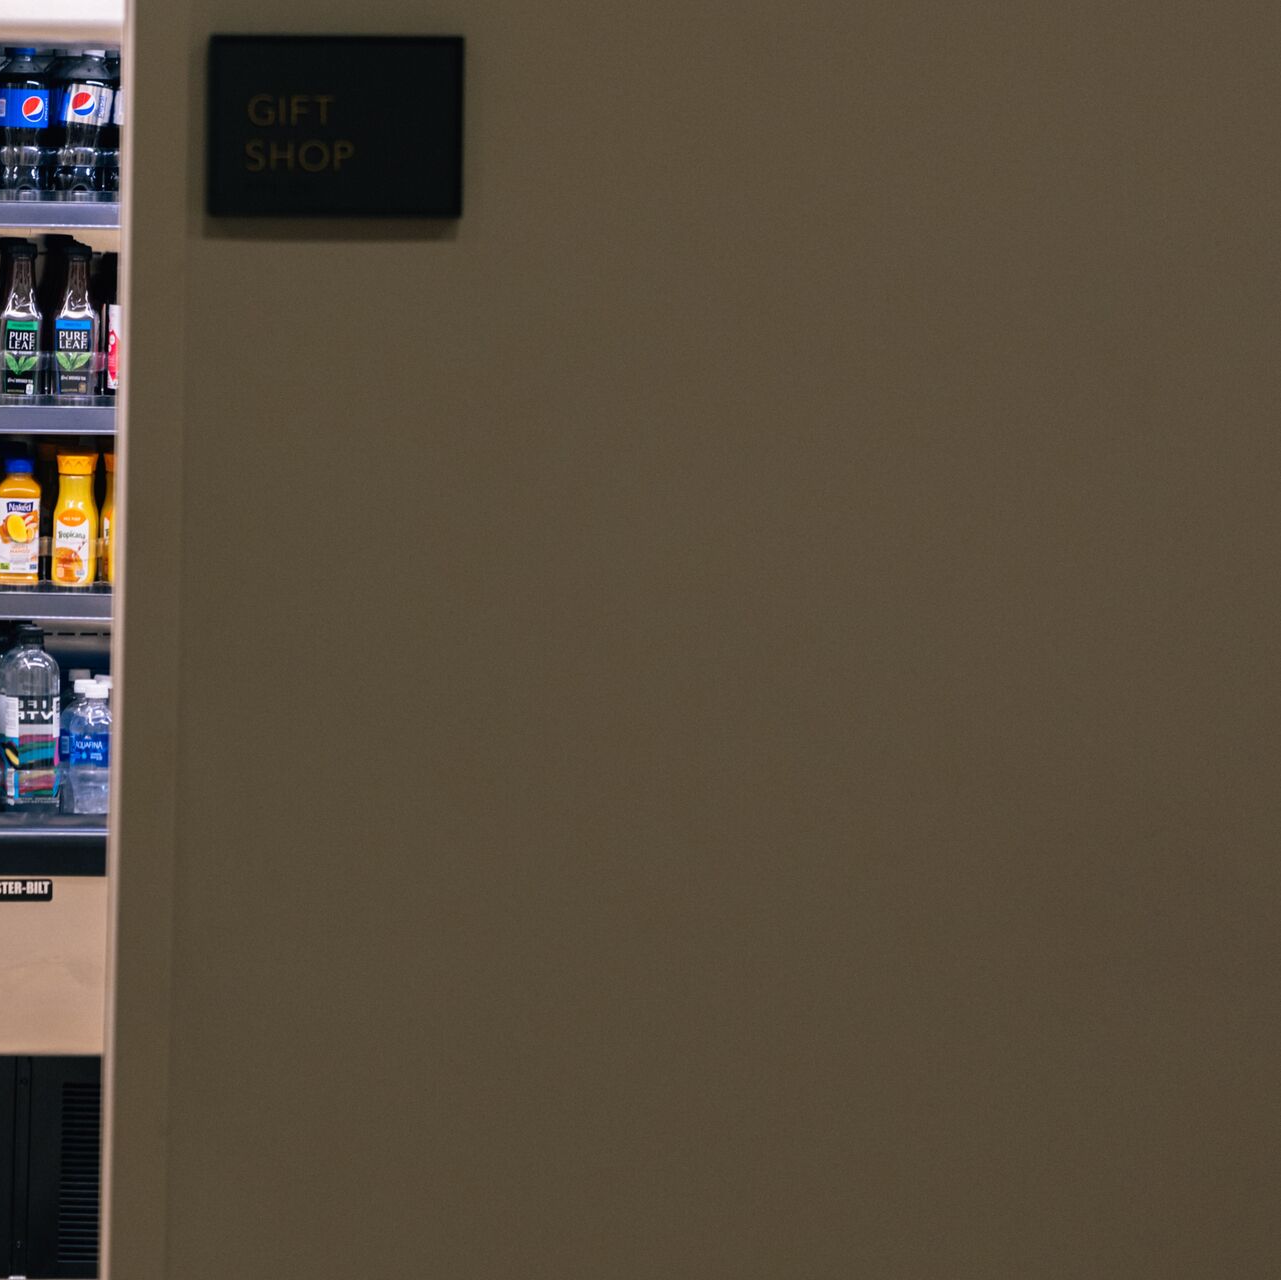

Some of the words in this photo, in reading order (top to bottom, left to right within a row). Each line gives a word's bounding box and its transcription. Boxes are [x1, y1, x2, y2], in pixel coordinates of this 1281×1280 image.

[246, 93, 335, 128] GIFT
[244, 138, 356, 173] SHOP
[9, 331, 35, 341] PURE
[59, 330, 88, 340] PURE
[8, 340, 35, 350] LEAF
[59, 340, 87, 350] LEAF
[58, 529, 86, 539] Tropicana
